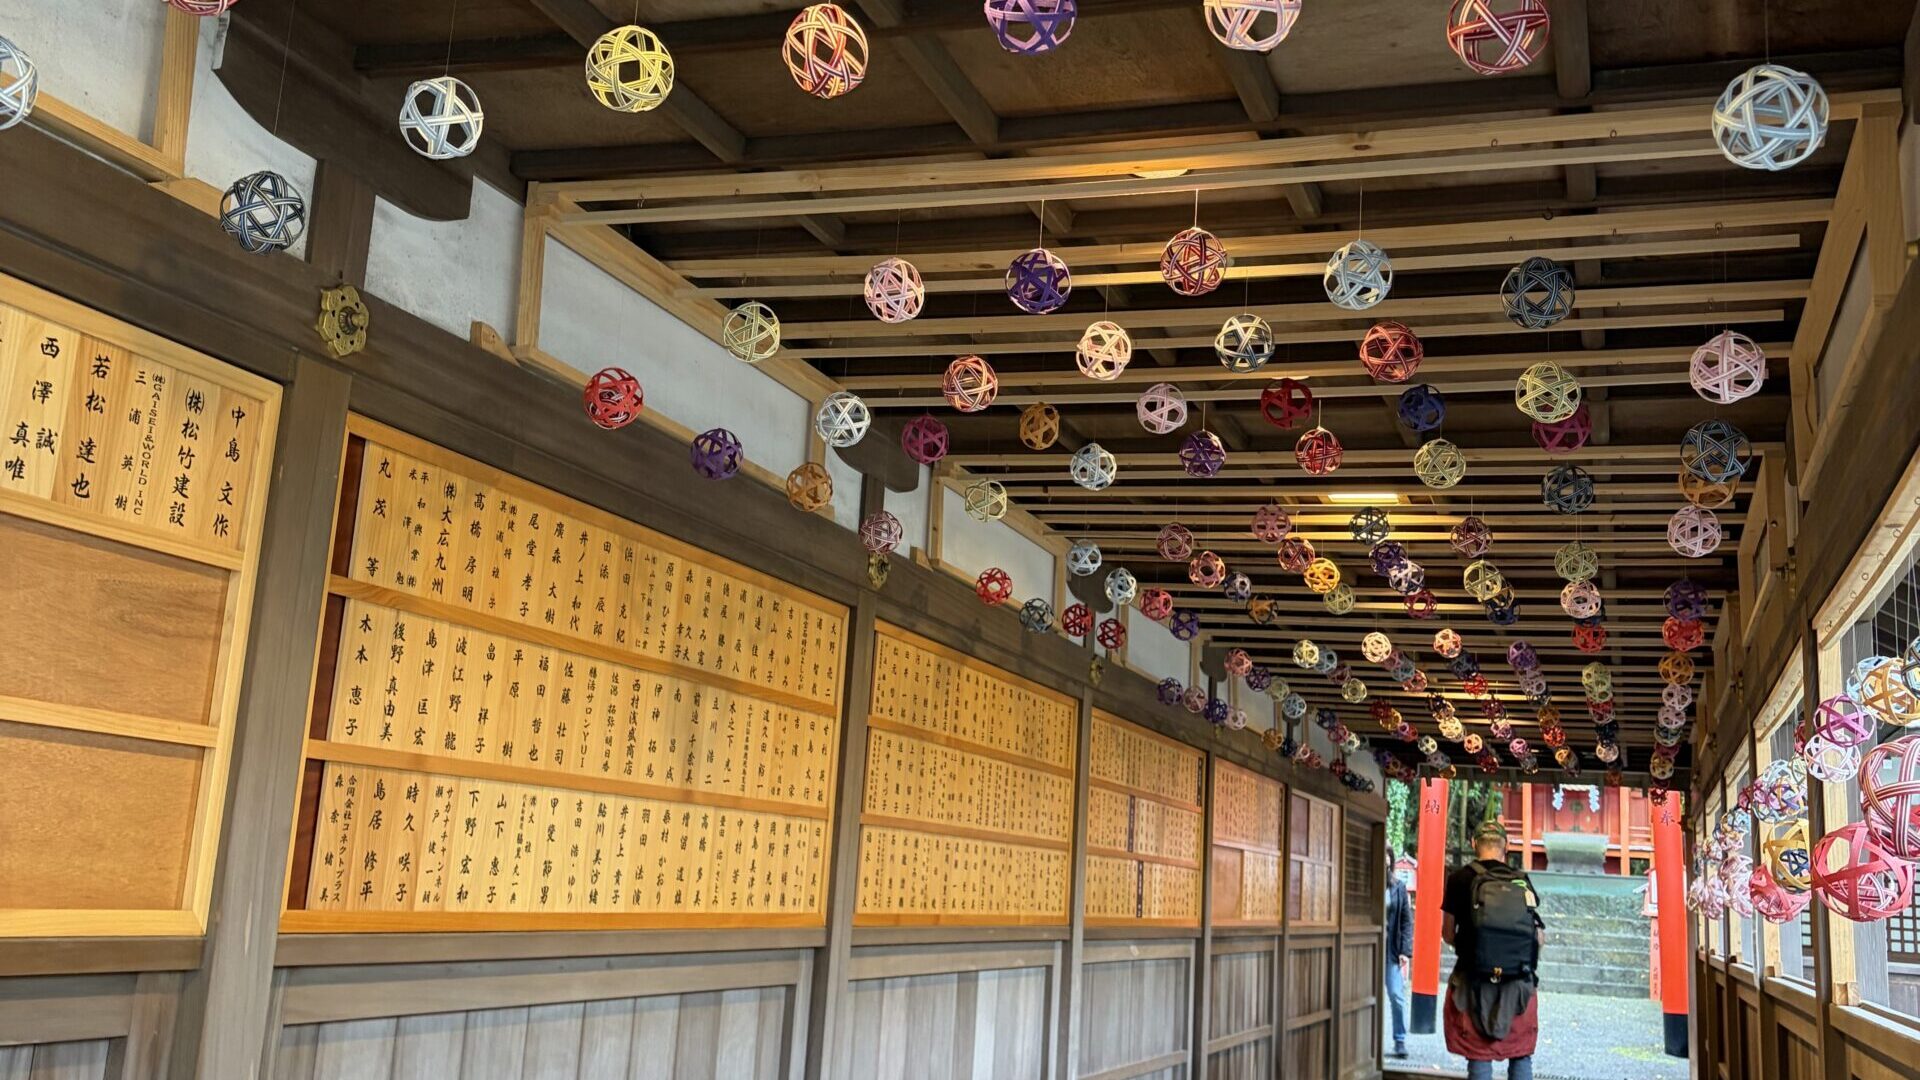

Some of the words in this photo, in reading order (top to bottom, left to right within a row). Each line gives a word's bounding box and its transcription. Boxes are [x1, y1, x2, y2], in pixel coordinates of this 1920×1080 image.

[71, 354, 111, 499] 若松達也
[114, 371, 147, 511] 三浦英樹
[213, 406, 246, 538] 中島文作
[365, 457, 392, 578] 丸茂等
[345, 613, 372, 737] 木本恵子
